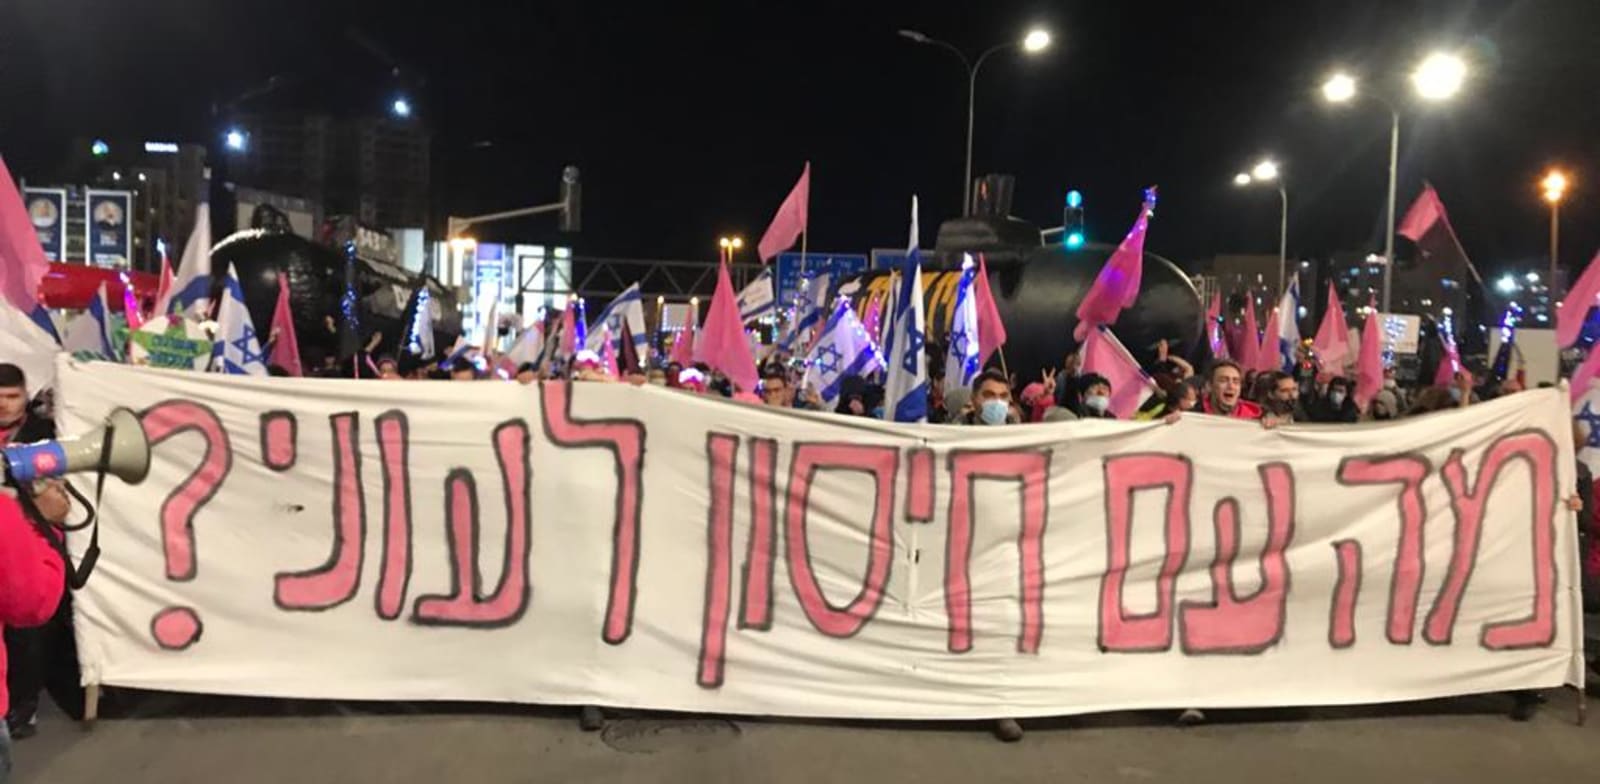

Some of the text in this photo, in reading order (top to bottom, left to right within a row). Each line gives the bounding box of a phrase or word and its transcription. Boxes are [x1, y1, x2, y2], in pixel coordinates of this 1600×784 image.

[140, 378, 1558, 689] מה עם חיסון לעוני?
